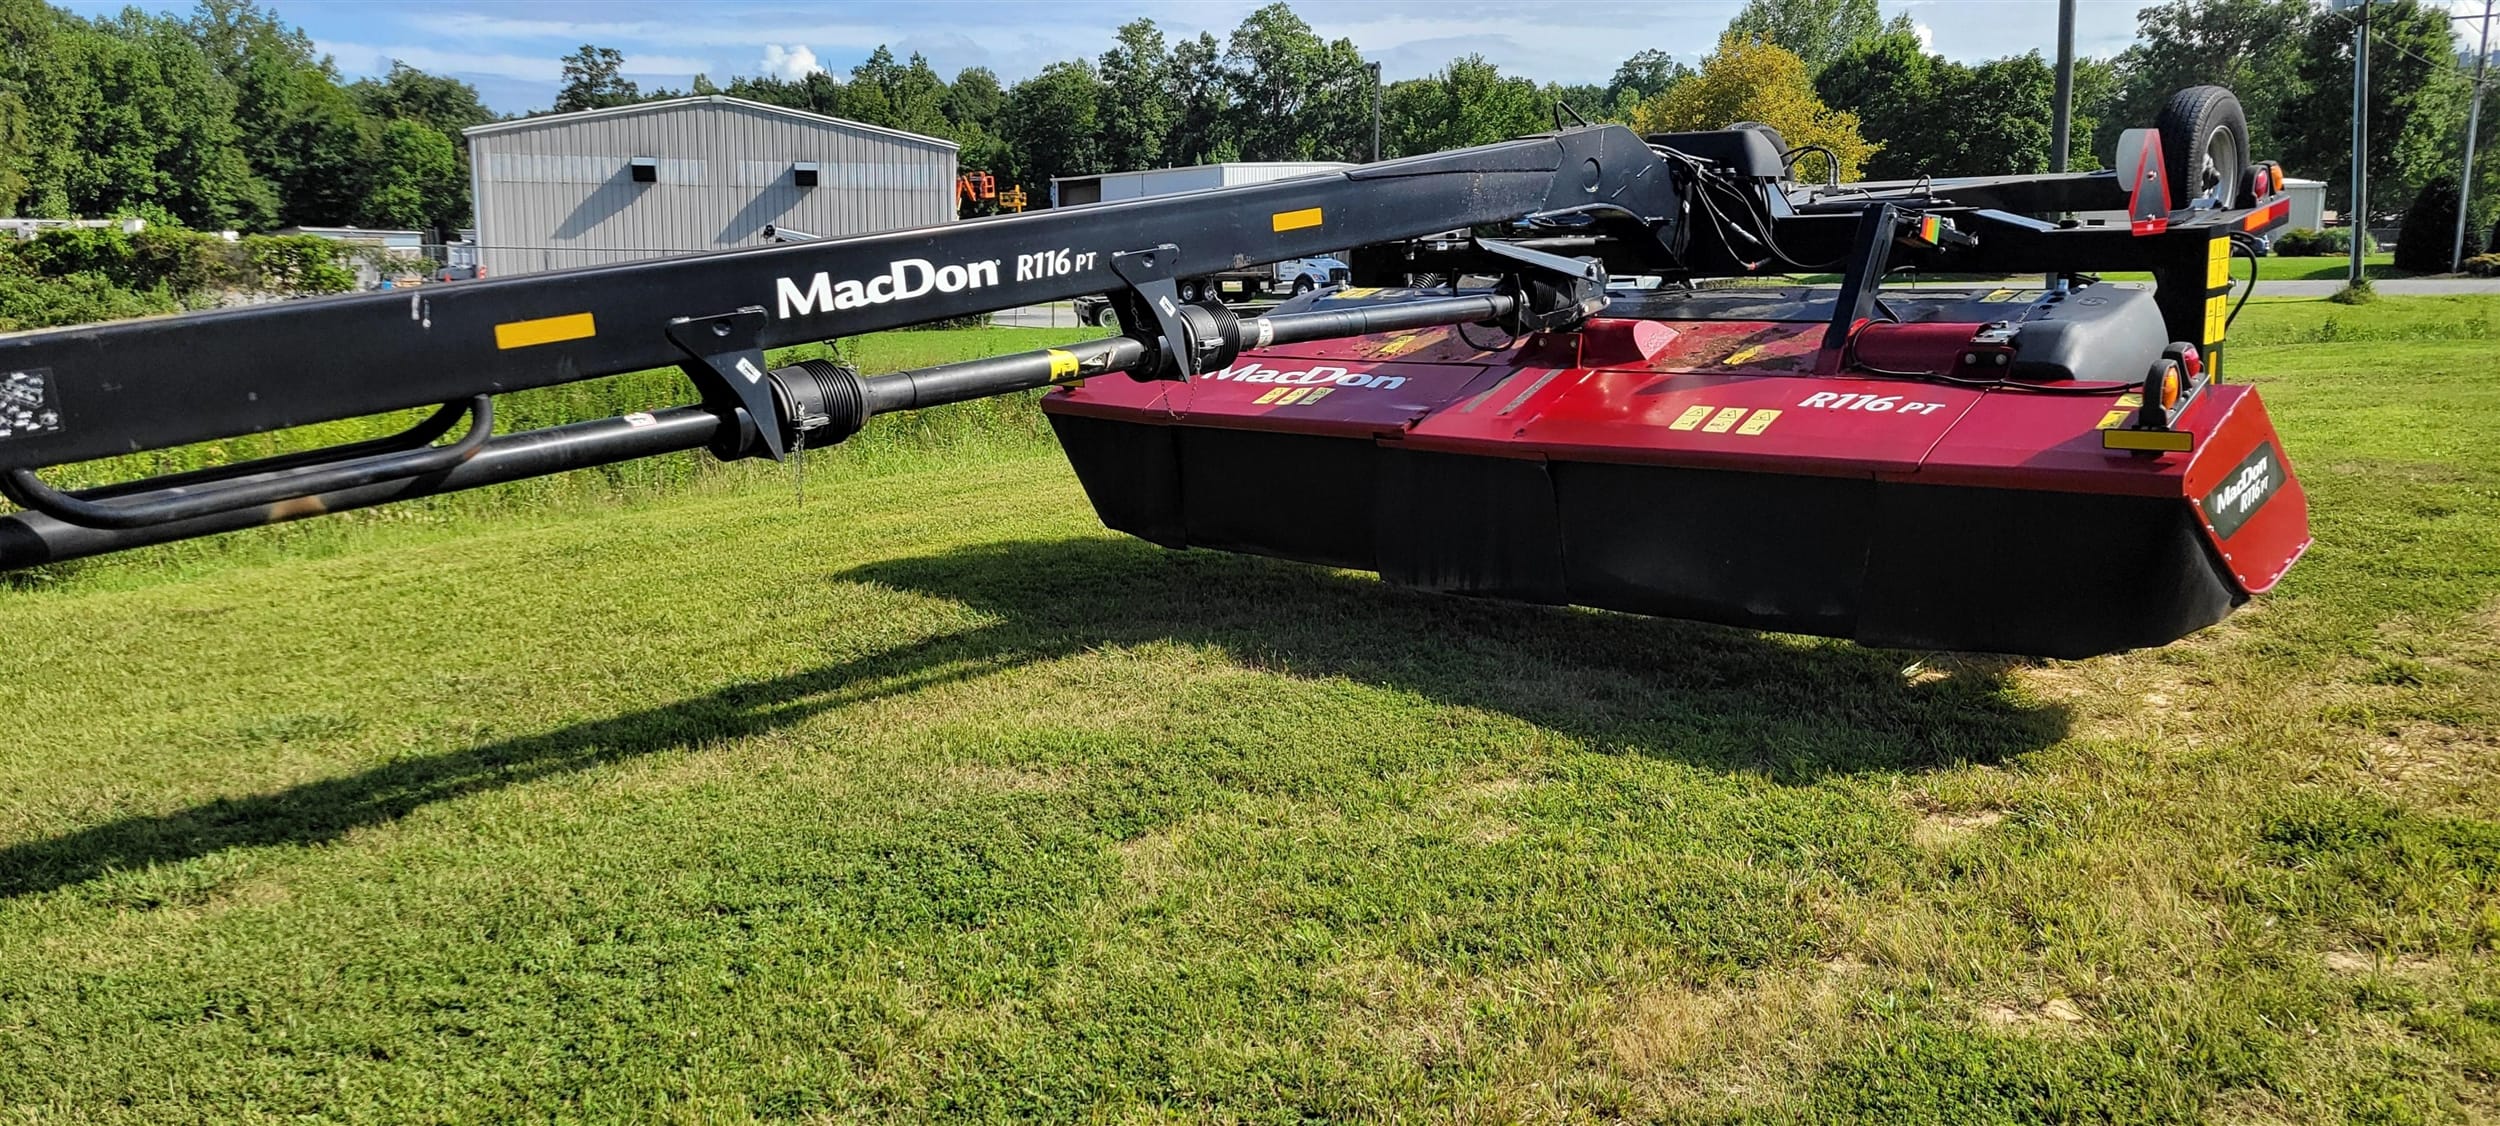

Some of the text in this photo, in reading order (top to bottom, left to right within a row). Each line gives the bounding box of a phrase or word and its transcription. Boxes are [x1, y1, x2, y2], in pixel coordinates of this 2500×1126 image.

[776, 248, 1097, 319] MacDon R116 PT
[1200, 363, 1408, 390] MacDon
[1797, 391, 1946, 415] R116 PT
[2216, 456, 2268, 514] MacDon
[2239, 475, 2269, 513] R116 PT
